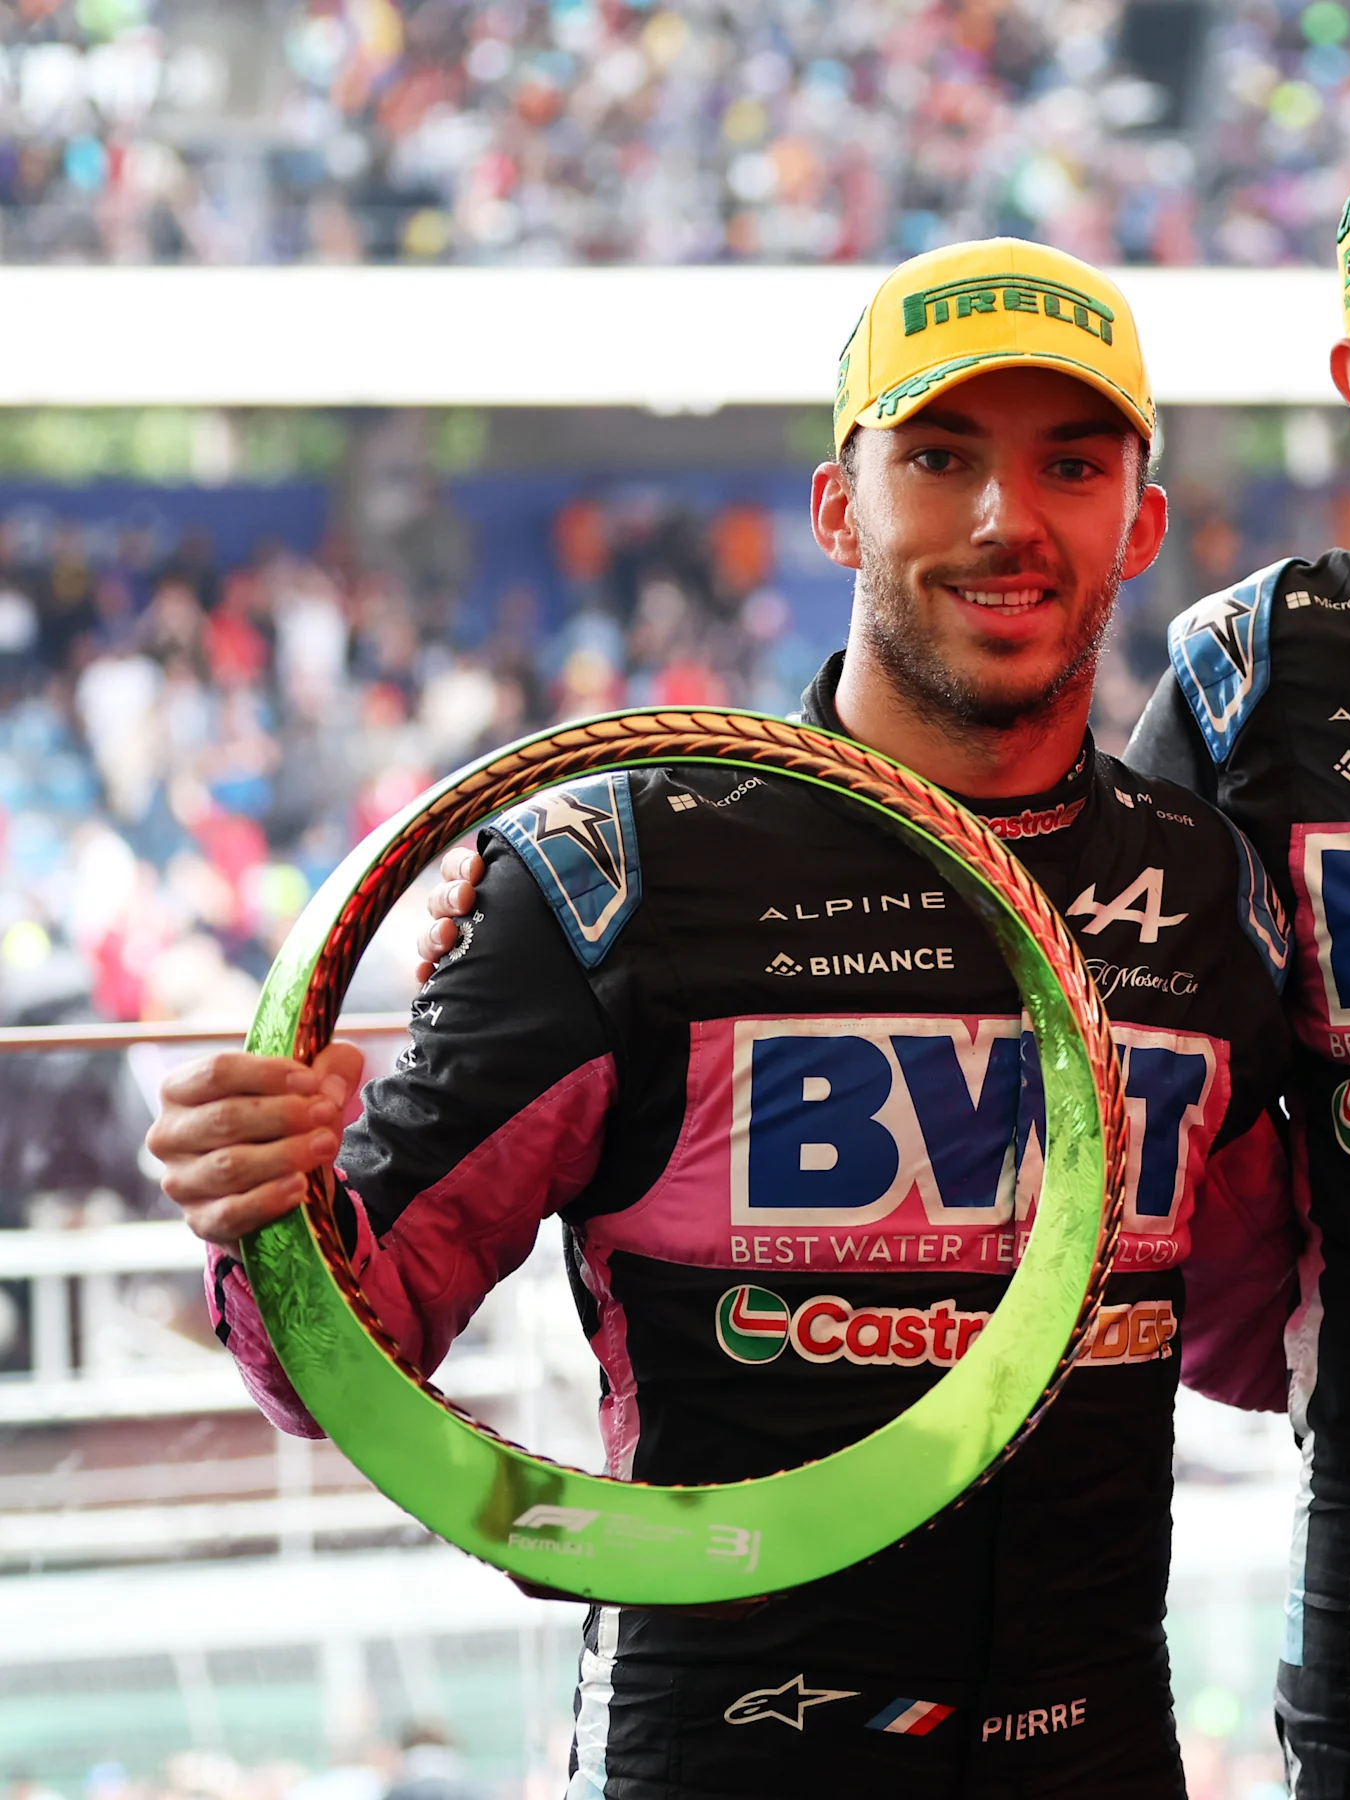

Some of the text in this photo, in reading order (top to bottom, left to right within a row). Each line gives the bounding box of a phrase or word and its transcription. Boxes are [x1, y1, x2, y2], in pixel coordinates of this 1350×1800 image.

[903, 273, 1115, 347] PIRELLI
[758, 890, 947, 922] ALPINE
[809, 947, 956, 978] BINANCE
[730, 1235, 819, 1265] BEST
[828, 1234, 962, 1263] WATER
[507, 1532, 584, 1556] Formula
[981, 1698, 1088, 1743] PIERRE
